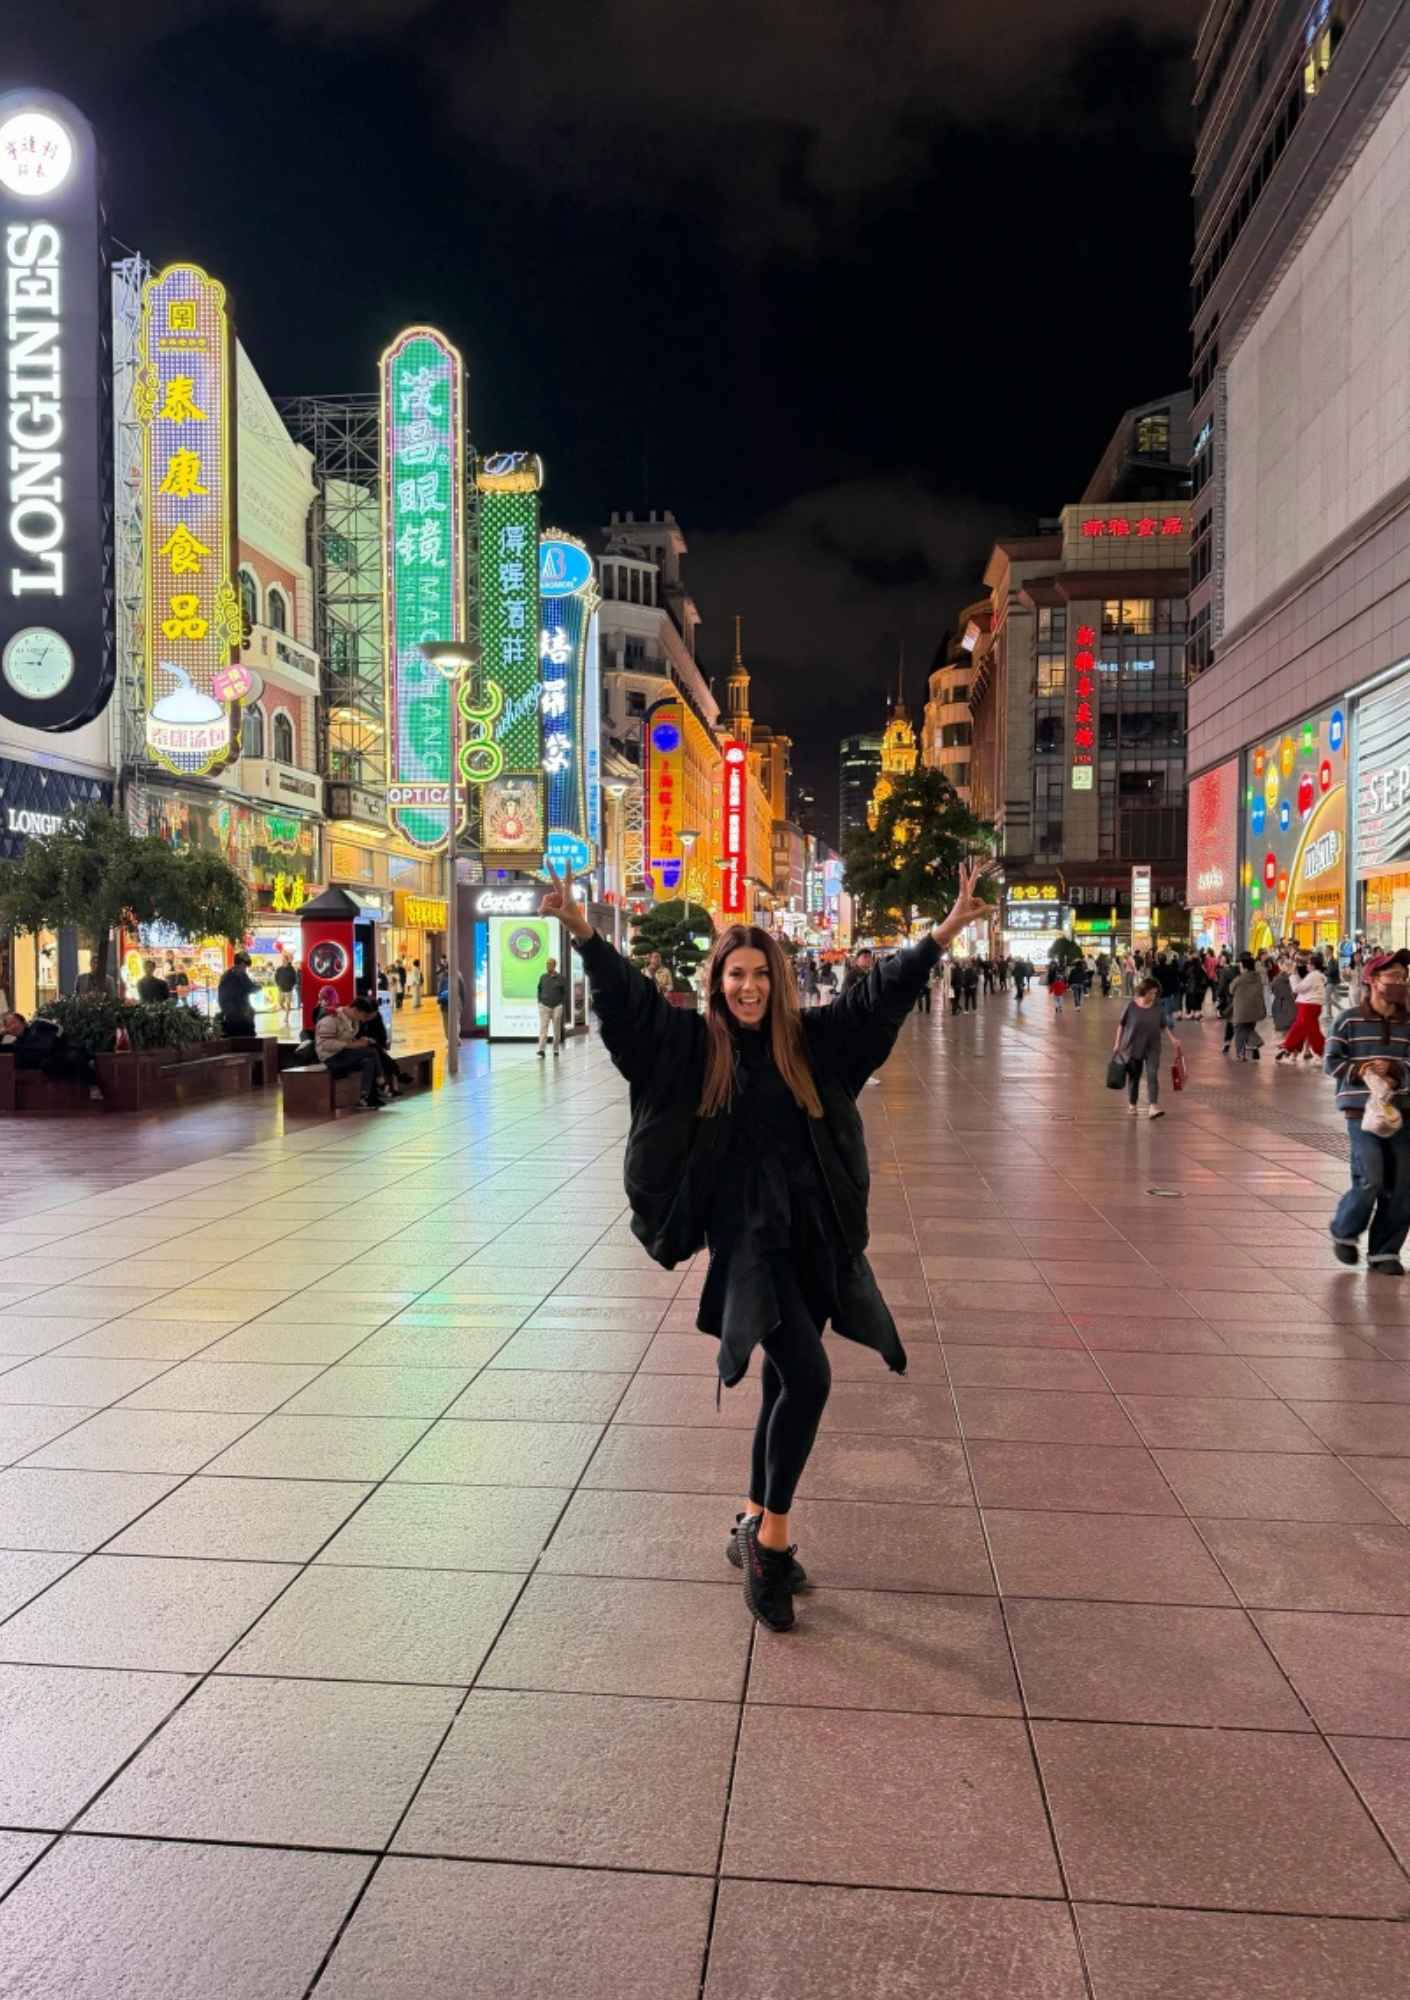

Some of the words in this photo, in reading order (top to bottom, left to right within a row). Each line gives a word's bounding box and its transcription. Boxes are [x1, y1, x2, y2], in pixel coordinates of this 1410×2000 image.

[7, 223, 64, 597] LONGINES
[158, 373, 215, 640] 泰康食品
[389, 788, 464, 804] OPTICAL
